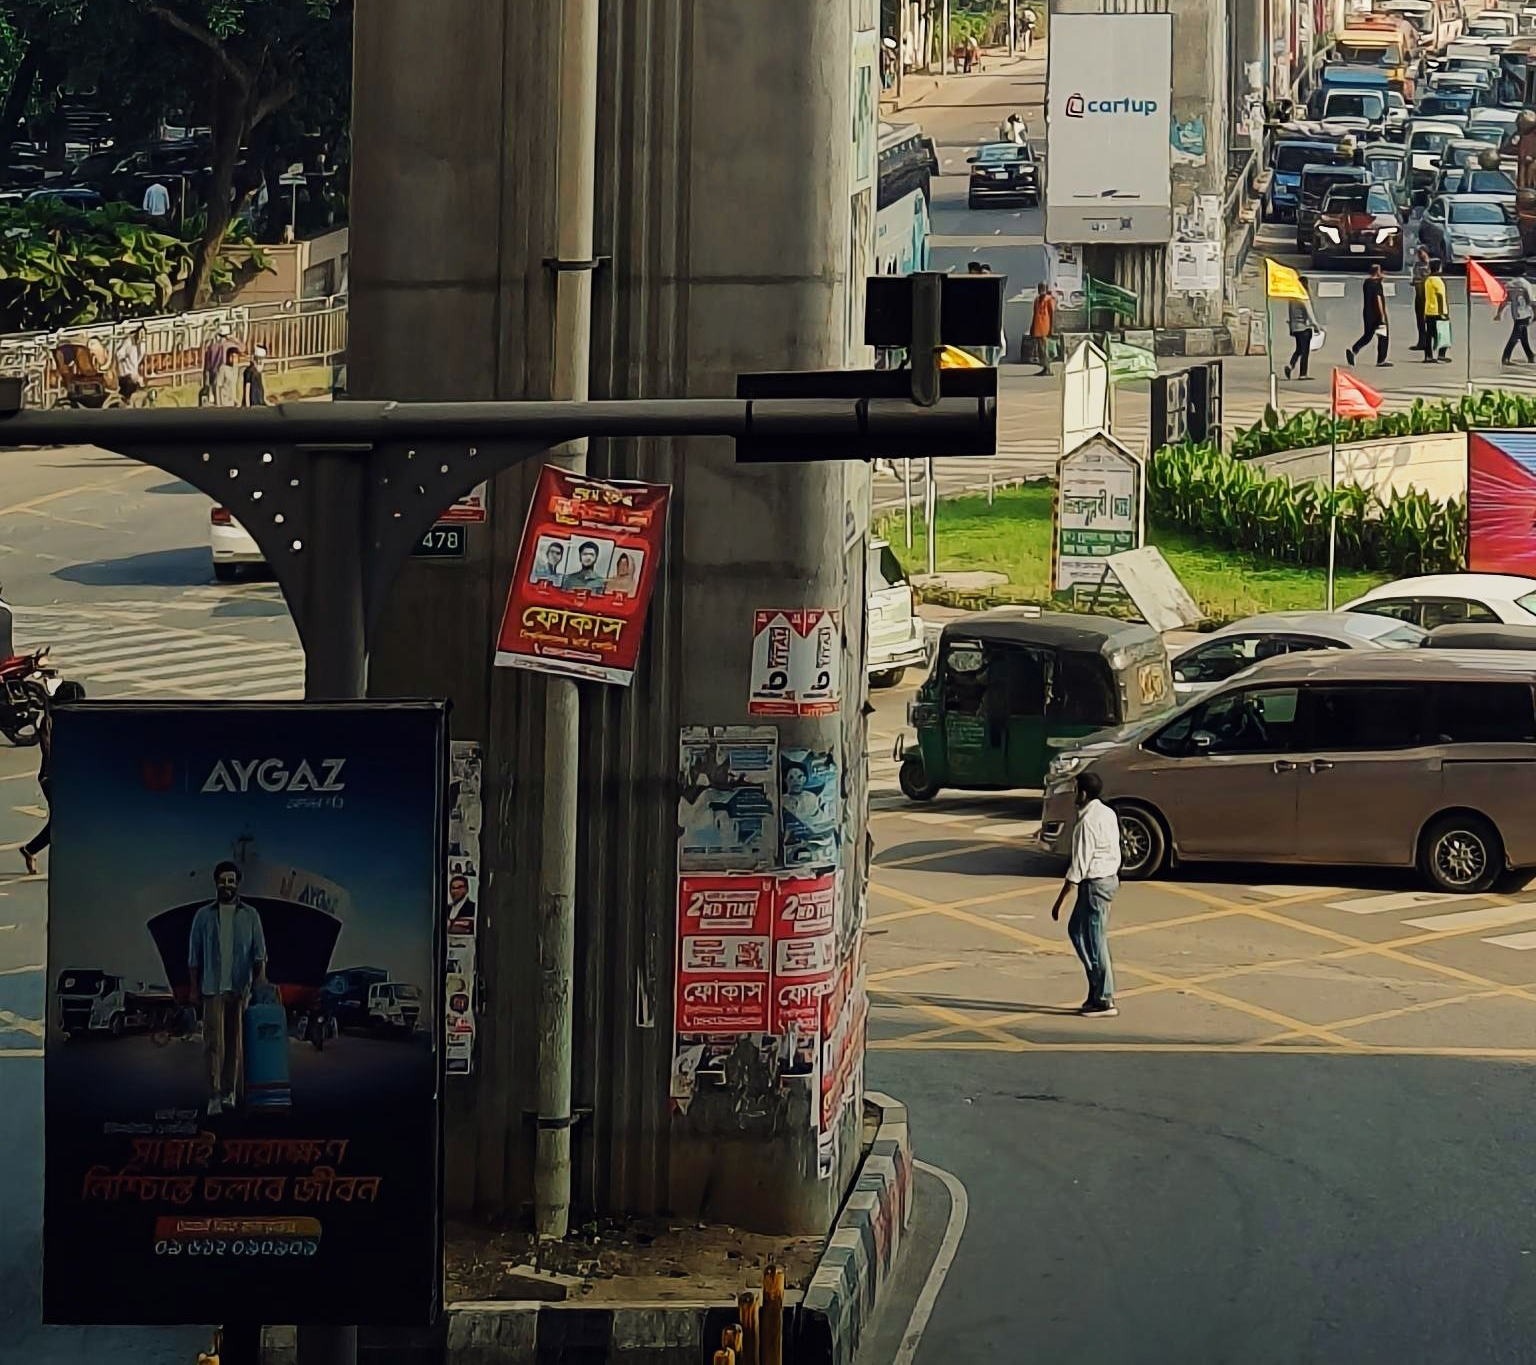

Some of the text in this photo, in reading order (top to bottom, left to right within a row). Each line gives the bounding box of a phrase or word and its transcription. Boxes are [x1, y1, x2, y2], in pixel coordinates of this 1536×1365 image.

[1088, 97, 1157, 116] cartup
[423, 532, 458, 548] 478
[522, 606, 627, 642] ফোকাস
[201, 758, 346, 793] AYGAZ
[684, 980, 766, 1004] ফোকাস
[221, 1138, 350, 1166] সারাক্ষণ
[203, 1176, 287, 1203] চলবে
[293, 1165, 382, 1203] জীবন
